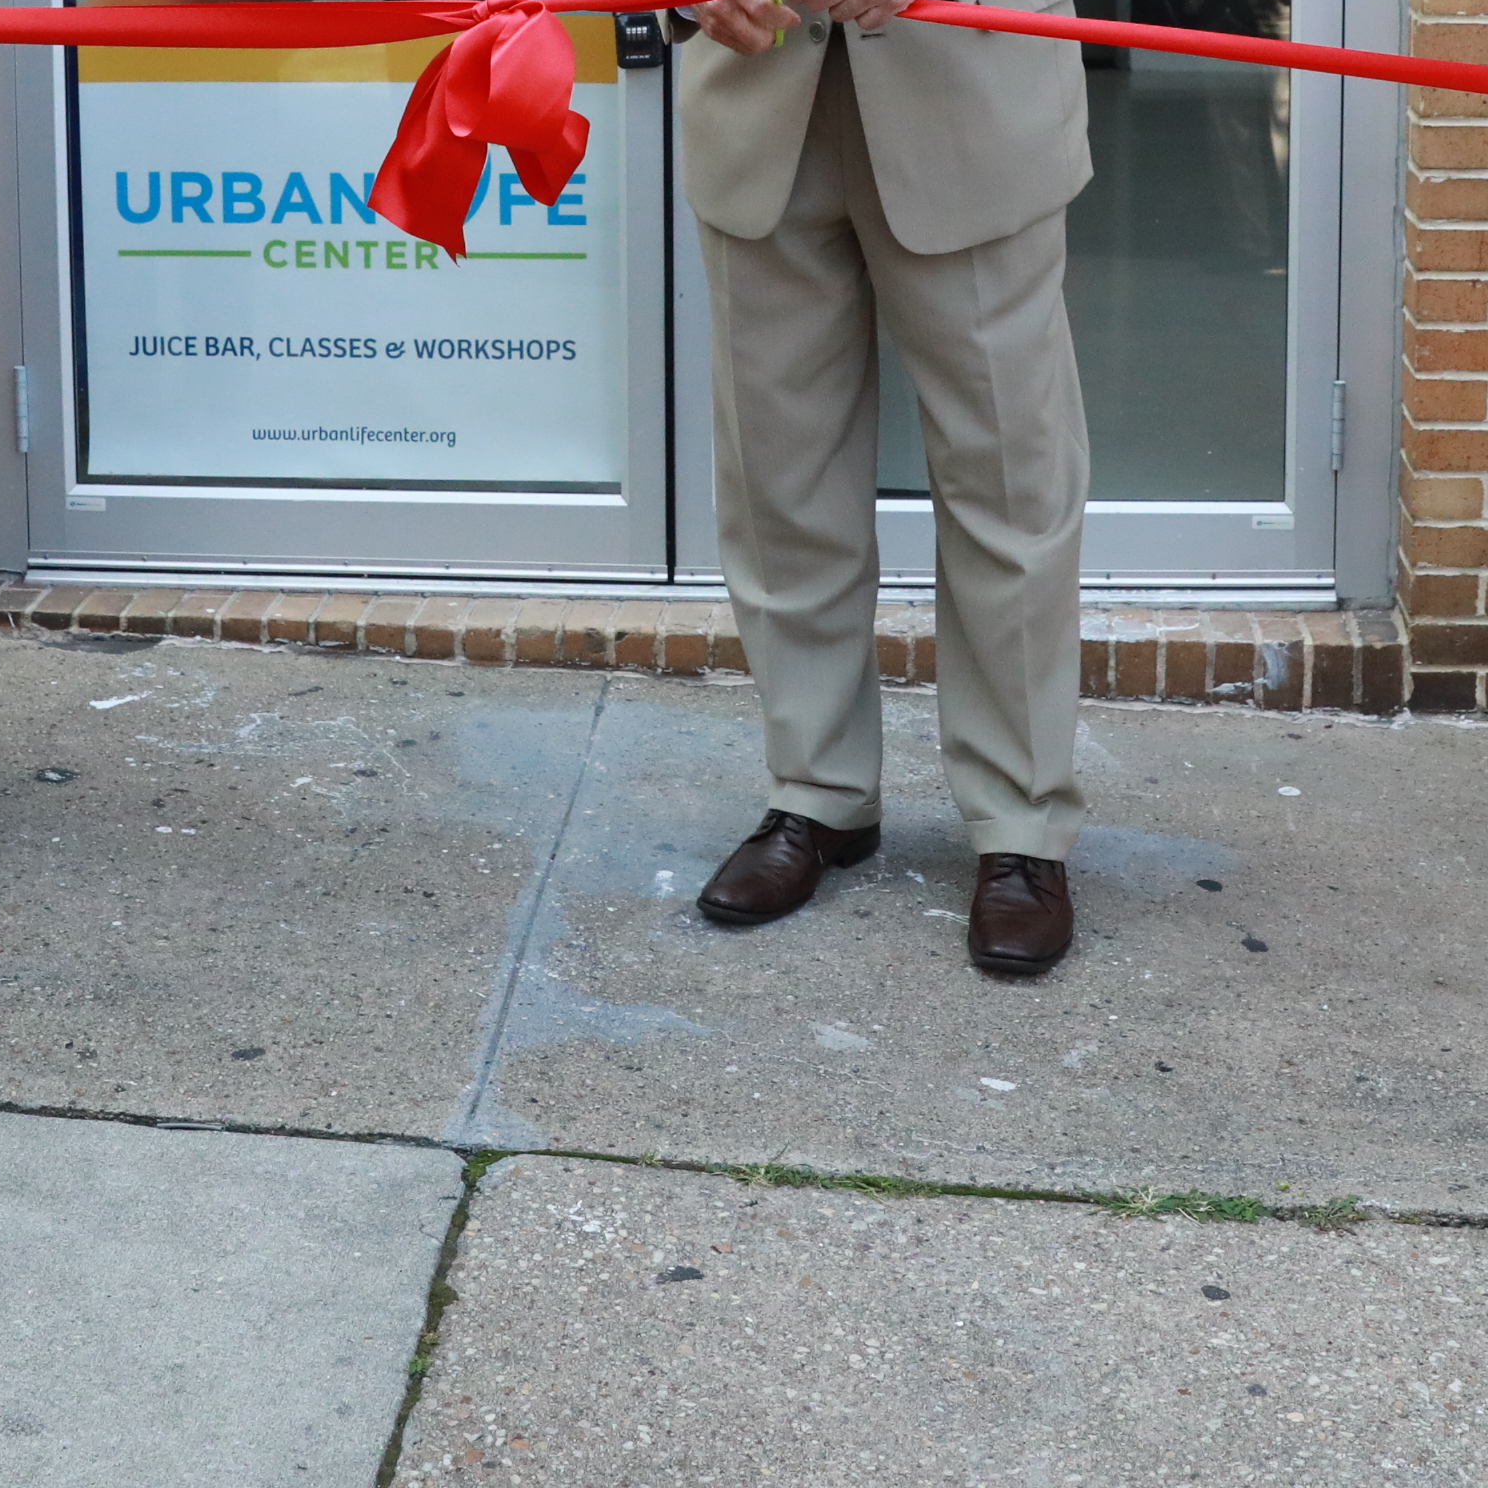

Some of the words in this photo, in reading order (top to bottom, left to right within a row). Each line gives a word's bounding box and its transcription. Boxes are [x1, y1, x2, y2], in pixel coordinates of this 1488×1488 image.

[115, 169, 376, 226] URBAN
[262, 239, 440, 270] CENTER
[129, 335, 199, 358] JUICE
[204, 336, 262, 361] BAR,
[268, 336, 378, 359] CLASSES
[384, 341, 407, 359] &
[413, 337, 577, 361] WORKSHOPS
[252, 425, 457, 449] www.urbanlifecenter.org
